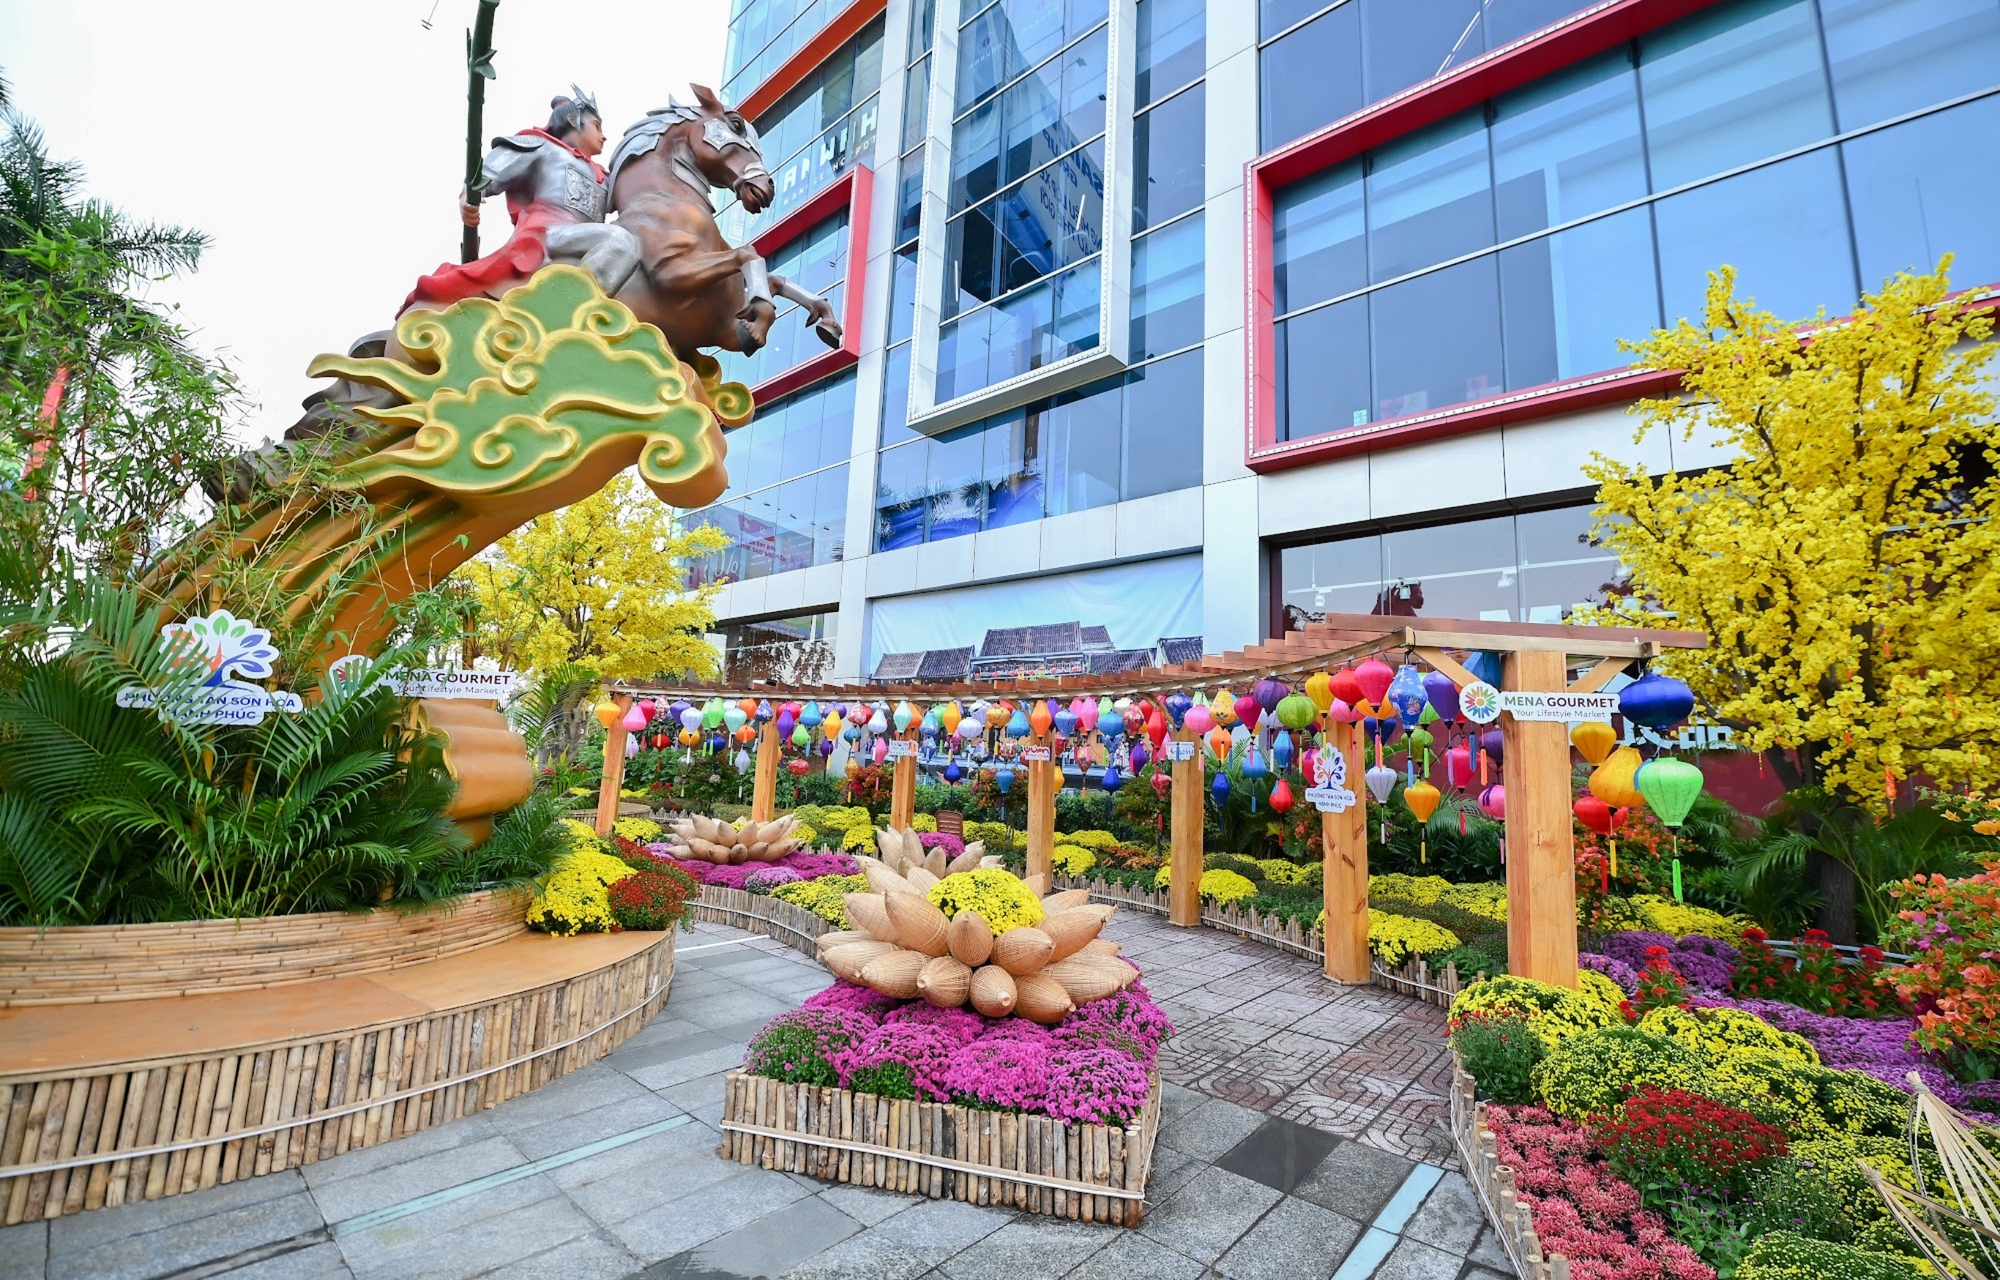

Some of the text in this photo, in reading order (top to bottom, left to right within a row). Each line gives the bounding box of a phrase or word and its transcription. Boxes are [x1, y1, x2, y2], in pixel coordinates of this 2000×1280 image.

[435, 673, 511, 685] GOURMET
[1504, 696, 1615, 708] MENA GOURMET
[1515, 709, 1606, 719] Your Lifestyle Market
